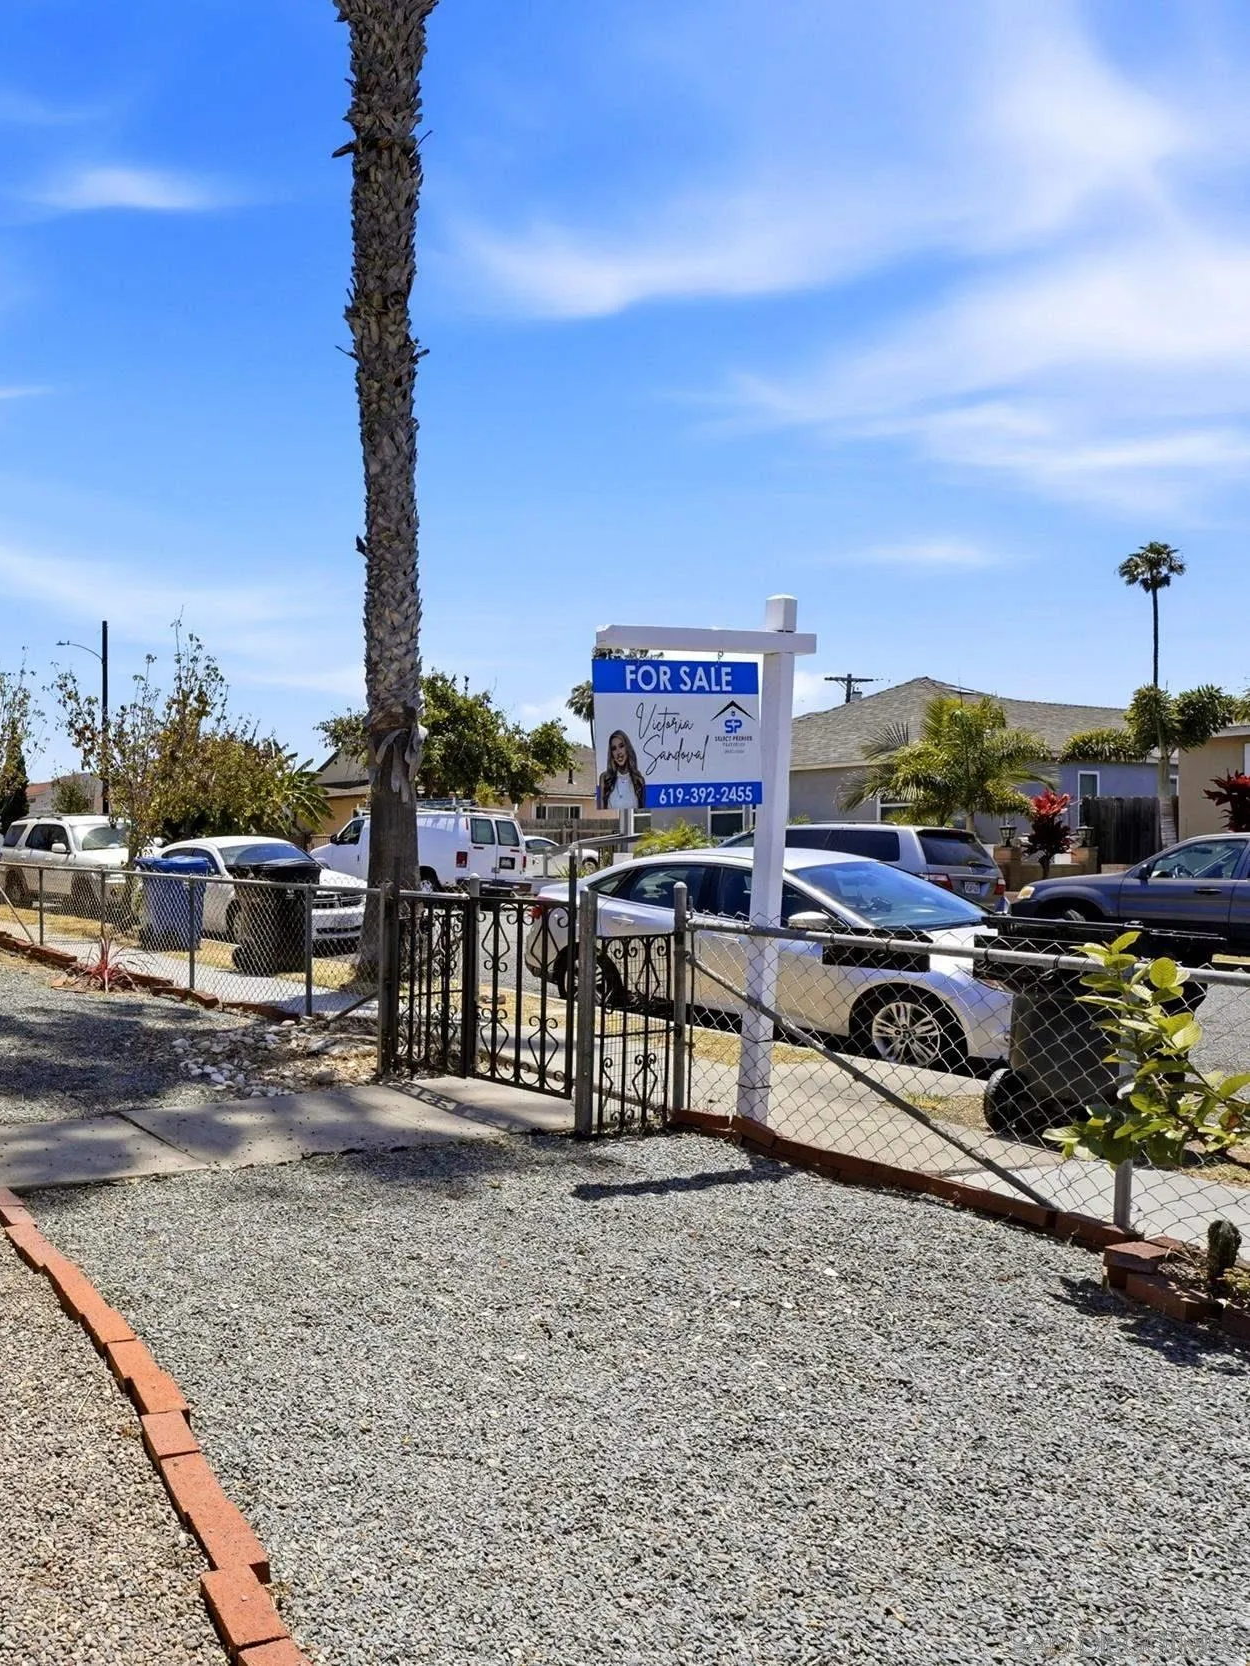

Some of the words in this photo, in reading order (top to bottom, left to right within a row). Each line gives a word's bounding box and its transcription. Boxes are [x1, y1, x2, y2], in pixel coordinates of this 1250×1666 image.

[625, 665, 672, 691] FOR
[680, 666, 732, 691] SALE
[636, 702, 693, 745] Victoria
[724, 719, 742, 734] SP
[643, 735, 709, 775] Sandoval
[659, 786, 752, 804] 619-392-2455
